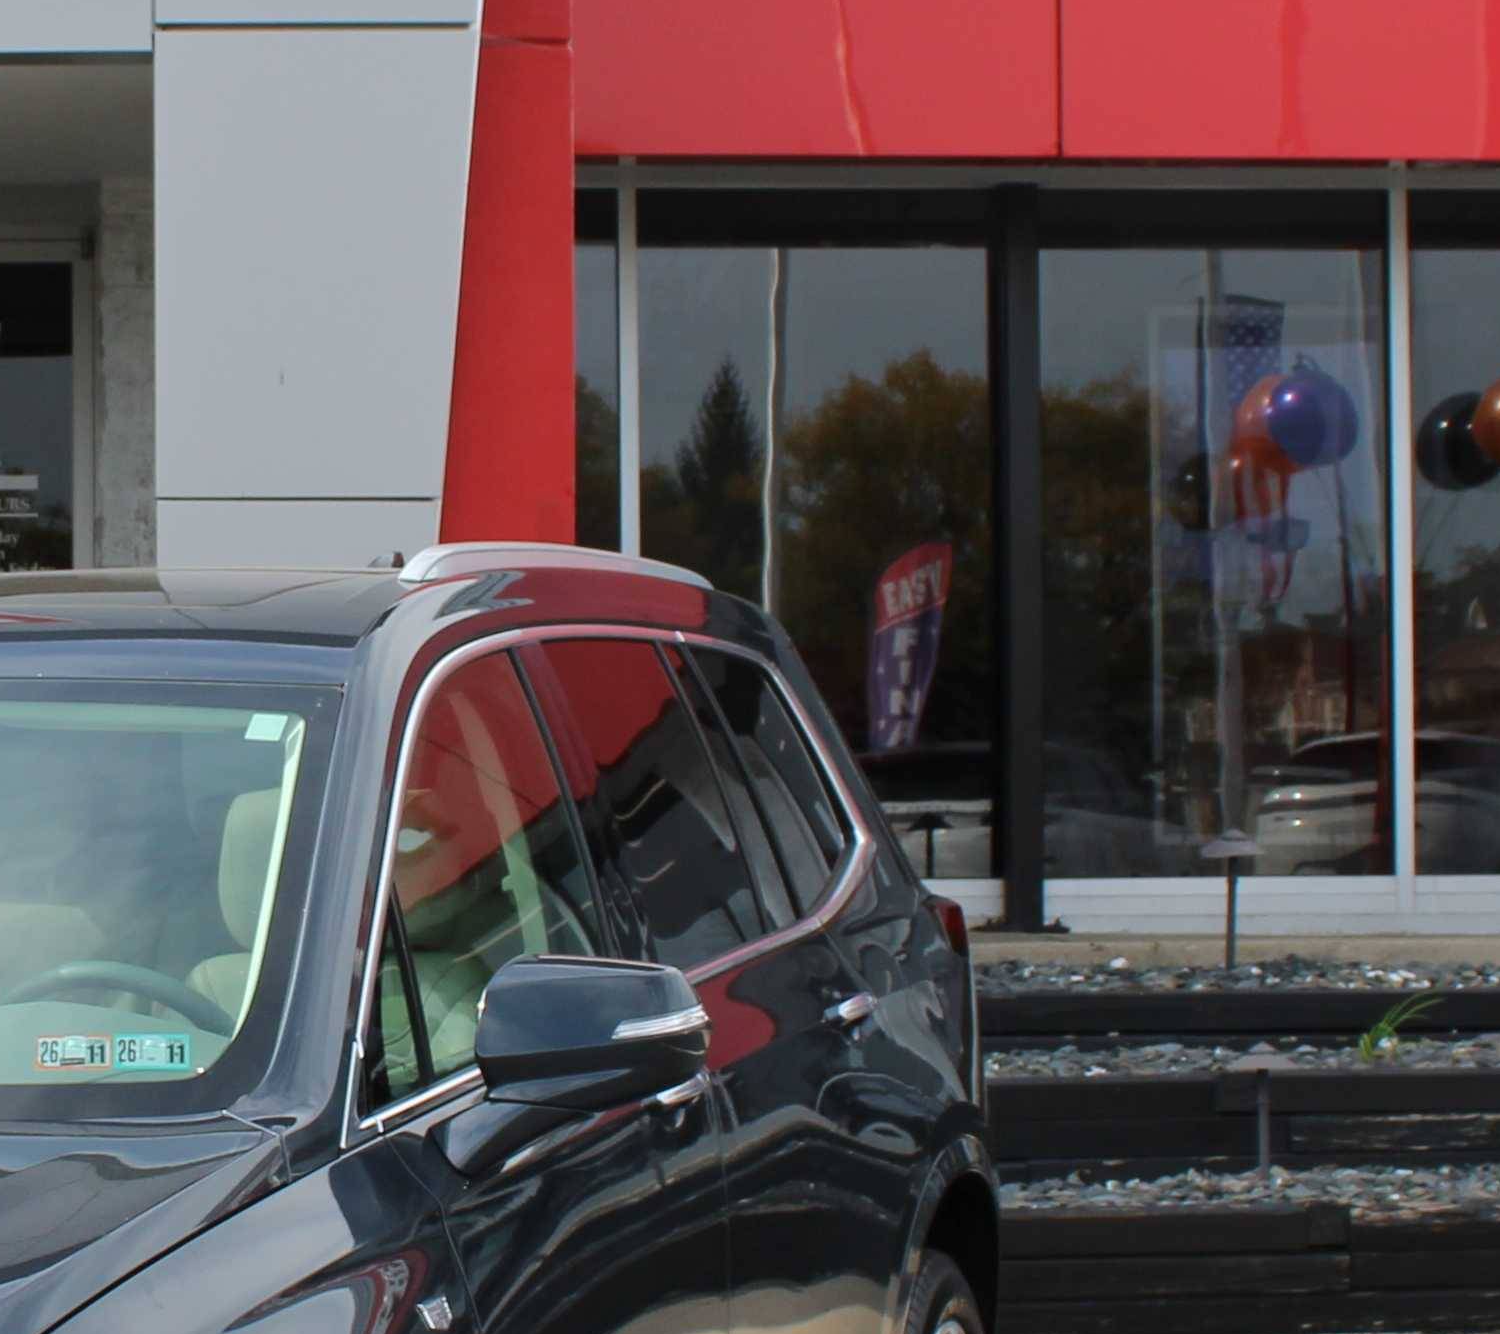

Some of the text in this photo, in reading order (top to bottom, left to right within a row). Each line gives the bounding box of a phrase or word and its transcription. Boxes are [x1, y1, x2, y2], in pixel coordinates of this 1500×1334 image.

[881, 559, 944, 619] EASY
[40, 1039, 60, 1064] 26
[117, 1038, 137, 1064] 26
